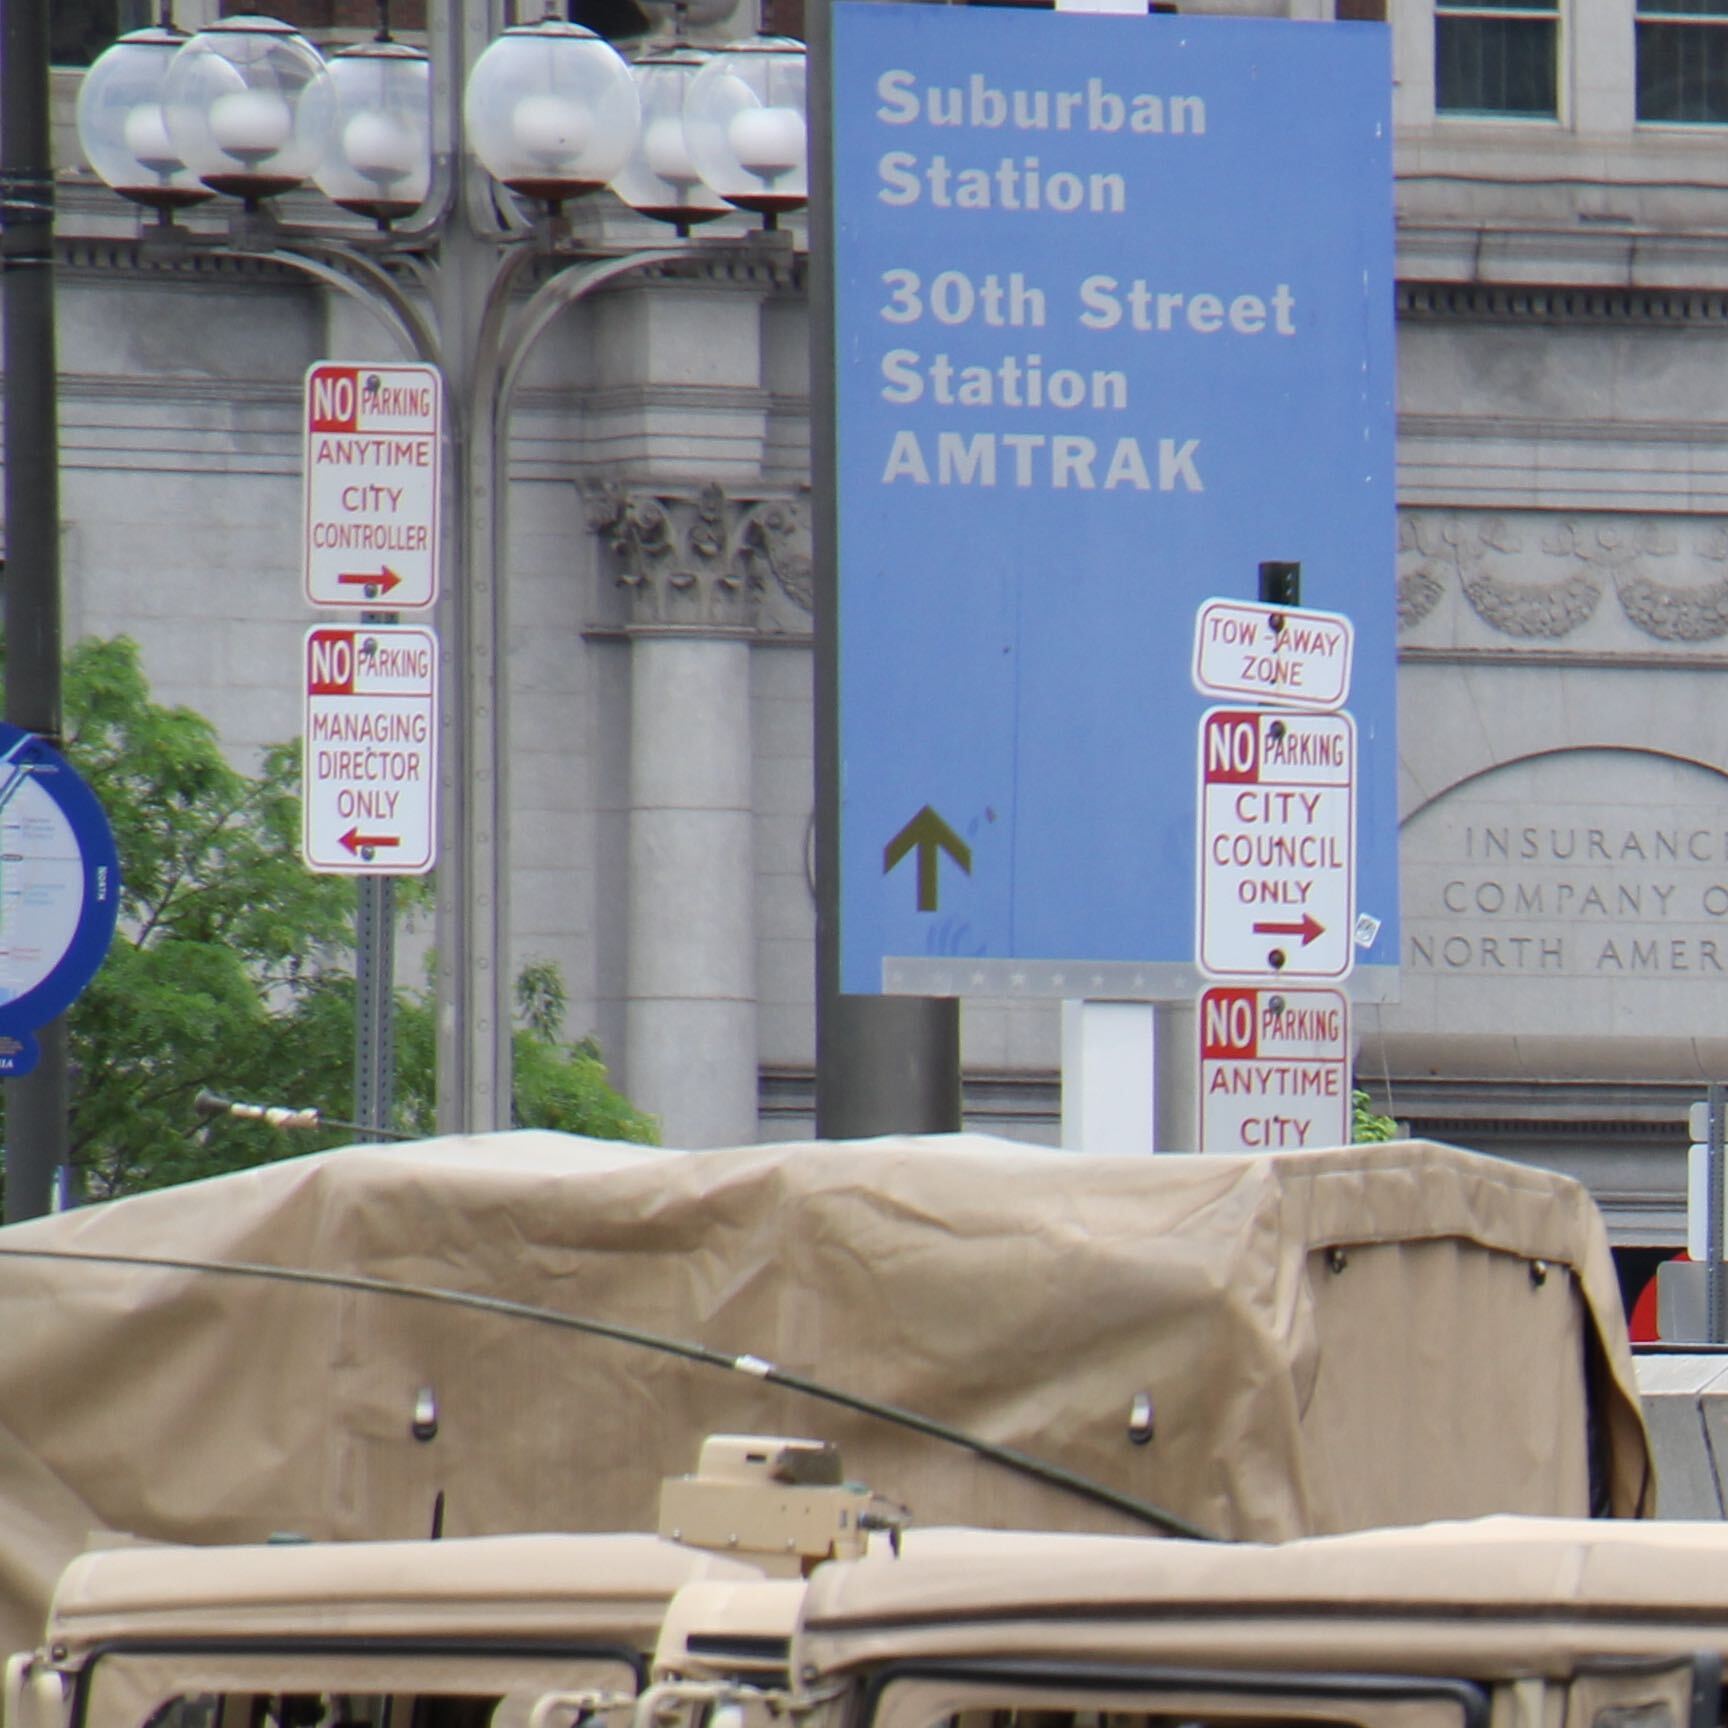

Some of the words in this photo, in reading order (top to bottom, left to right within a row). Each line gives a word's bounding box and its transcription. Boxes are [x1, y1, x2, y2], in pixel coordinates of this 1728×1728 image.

[875, 69, 1206, 135] Suburban
[876, 151, 1126, 213] Station
[880, 268, 1046, 327] 30th
[1079, 275, 1296, 335] Street
[881, 349, 1128, 409] Station
[313, 377, 354, 423] NO
[361, 387, 430, 418] PARKING
[316, 439, 430, 468] ANYTIME
[881, 431, 1204, 492] AMTRAK
[341, 484, 403, 513] CITY
[313, 522, 428, 551] CONTROLLER
[311, 640, 351, 686] NO
[357, 648, 429, 679] PARKING
[1241, 655, 1304, 687] ZONE
[312, 712, 427, 744] MANAGING
[1208, 721, 1255, 773] NO
[1264, 733, 1344, 767] PARKING
[318, 750, 421, 781] DIRECTOR
[337, 789, 401, 819] ONLY
[1235, 790, 1321, 825] CITY
[1212, 833, 1343, 869] COUNCIL
[1238, 878, 1313, 905] ONLY
[1443, 880, 1677, 917] COMPANY
[1410, 935, 1564, 971] NORTH
[1206, 998, 1253, 1048] NO
[1261, 1008, 1340, 1043] PARKING
[1210, 1067, 1340, 1096] ANYTIME
[1240, 1117, 1312, 1147] CITY
